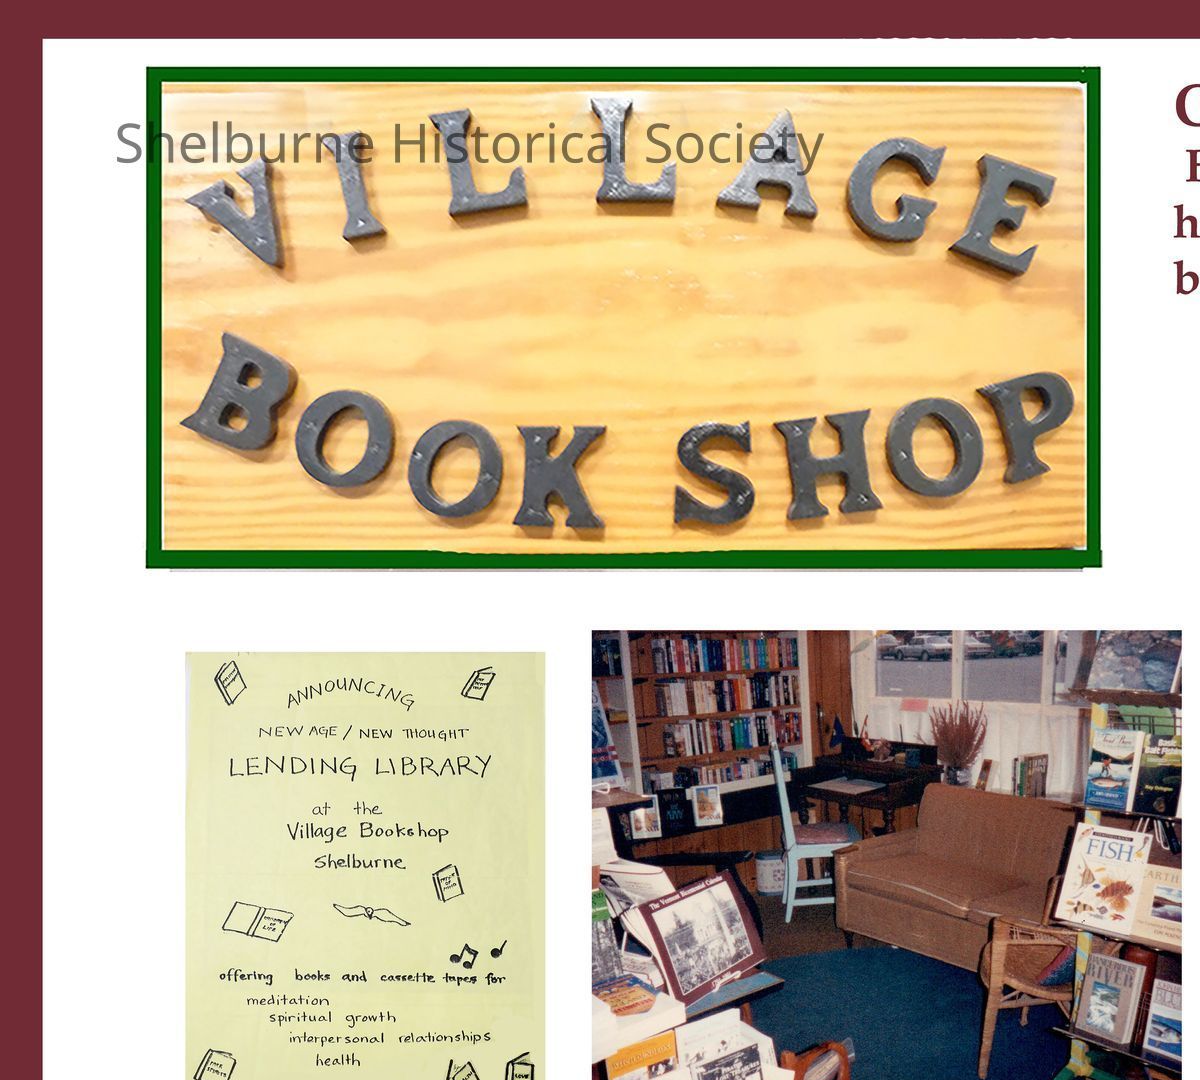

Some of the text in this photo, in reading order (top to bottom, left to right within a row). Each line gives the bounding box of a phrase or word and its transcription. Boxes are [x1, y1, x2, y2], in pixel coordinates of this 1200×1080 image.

[185, 96, 1057, 277] VILLAGE
[180, 331, 1075, 530] BOOK SHOP
[287, 677, 415, 711] ANNOUNCING
[259, 726, 304, 738] NEW
[308, 726, 338, 738] AGE
[360, 728, 392, 739] NEW
[402, 728, 470, 741] THOUGHT
[229, 755, 492, 782] LENDING LIBRARY
[312, 801, 383, 815] at the
[287, 822, 449, 843] Village Bookshop
[1086, 837, 1135, 863] FISH
[314, 854, 407, 869] Shelburne
[219, 969, 506, 986] offering books and cassette tapes for
[246, 995, 330, 1006] meditation
[269, 1011, 397, 1028] spiritual growth
[289, 1030, 492, 1044] interpersonal relationships
[316, 1053, 361, 1067] health
